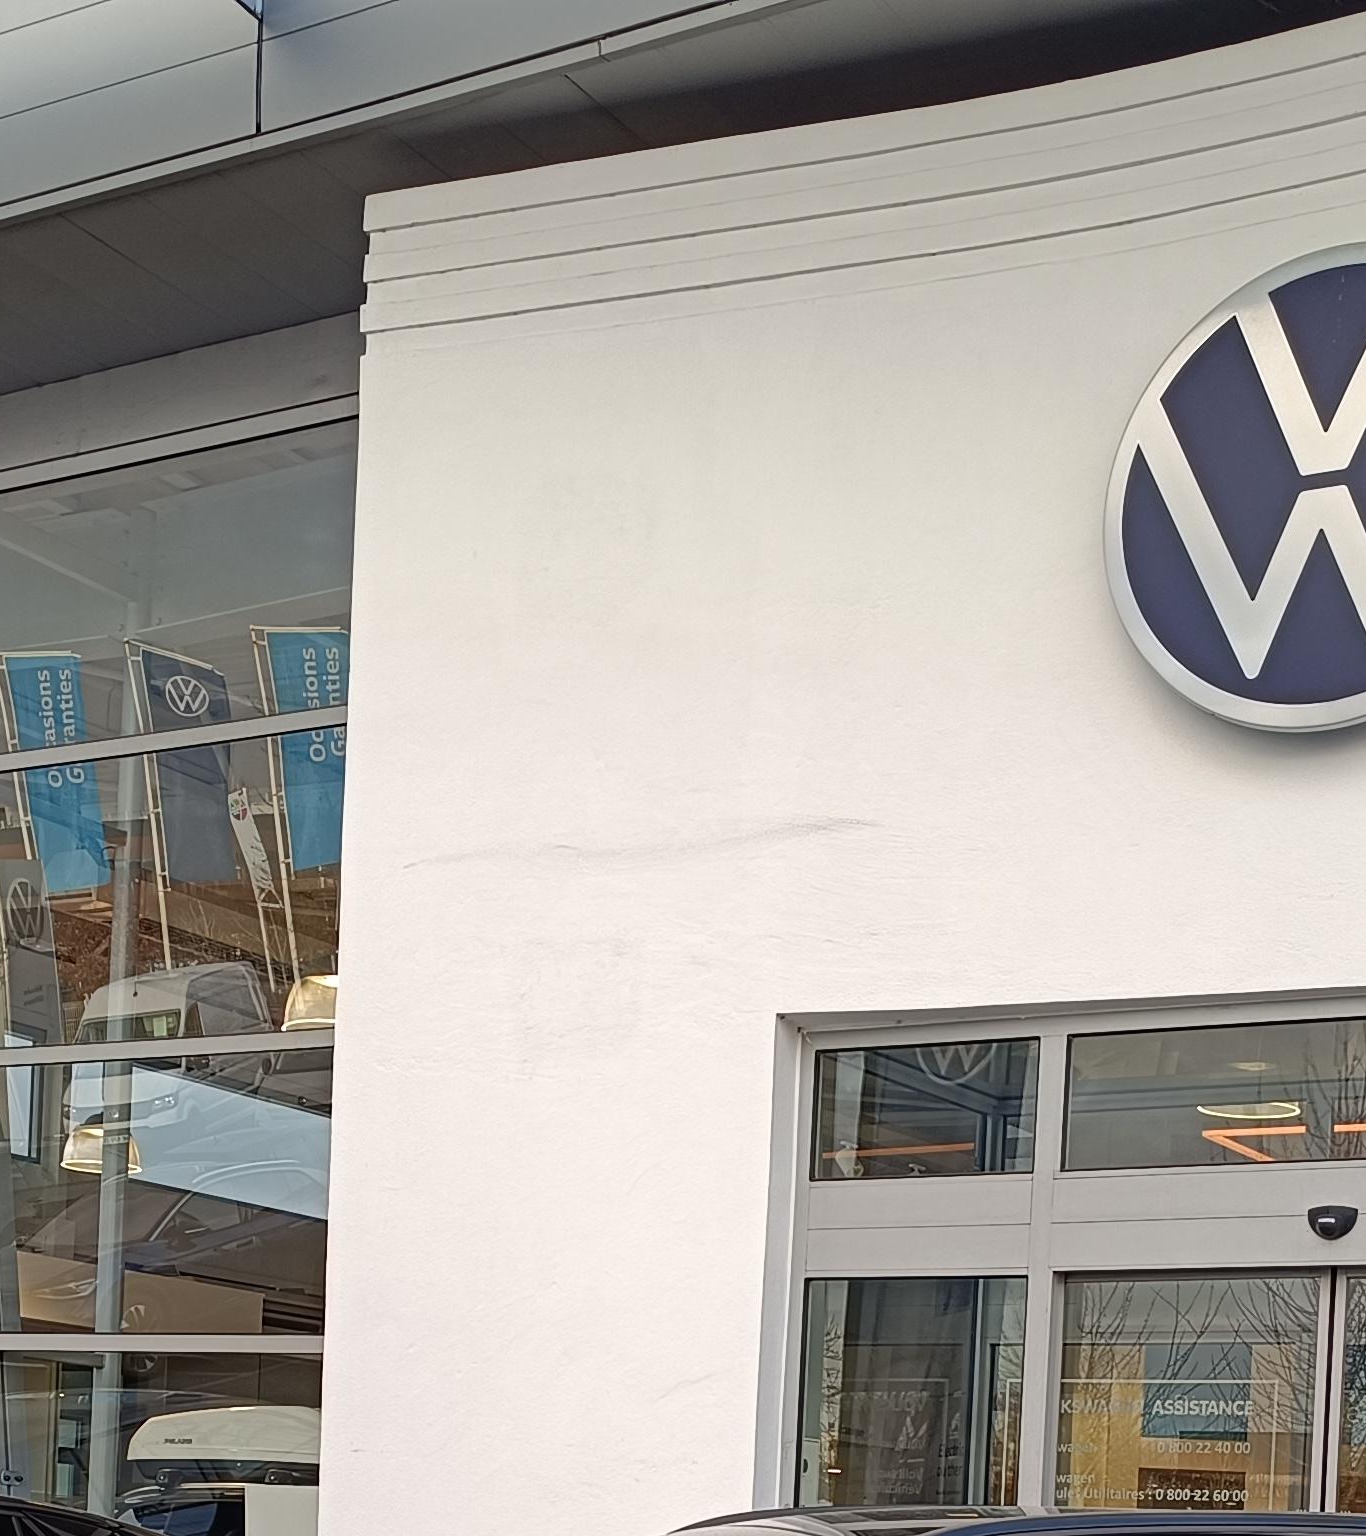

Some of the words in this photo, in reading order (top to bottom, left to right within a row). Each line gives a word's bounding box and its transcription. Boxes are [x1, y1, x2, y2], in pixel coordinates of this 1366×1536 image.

[303, 648, 326, 762] Ocsions
[324, 648, 346, 757] Ganties
[1152, 1400, 1254, 1416] ASSISTANCE
[1197, 1442, 1211, 1453] 22
[1215, 1442, 1230, 1454] 40
[1235, 1442, 1251, 1454] 00
[1084, 1488, 1145, 1500] Utilitaires
[1166, 1489, 1191, 1501] 800
[1194, 1489, 1209, 1501] 22
[1213, 1489, 1230, 1501] 60
[1232, 1489, 1249, 1501] 00
